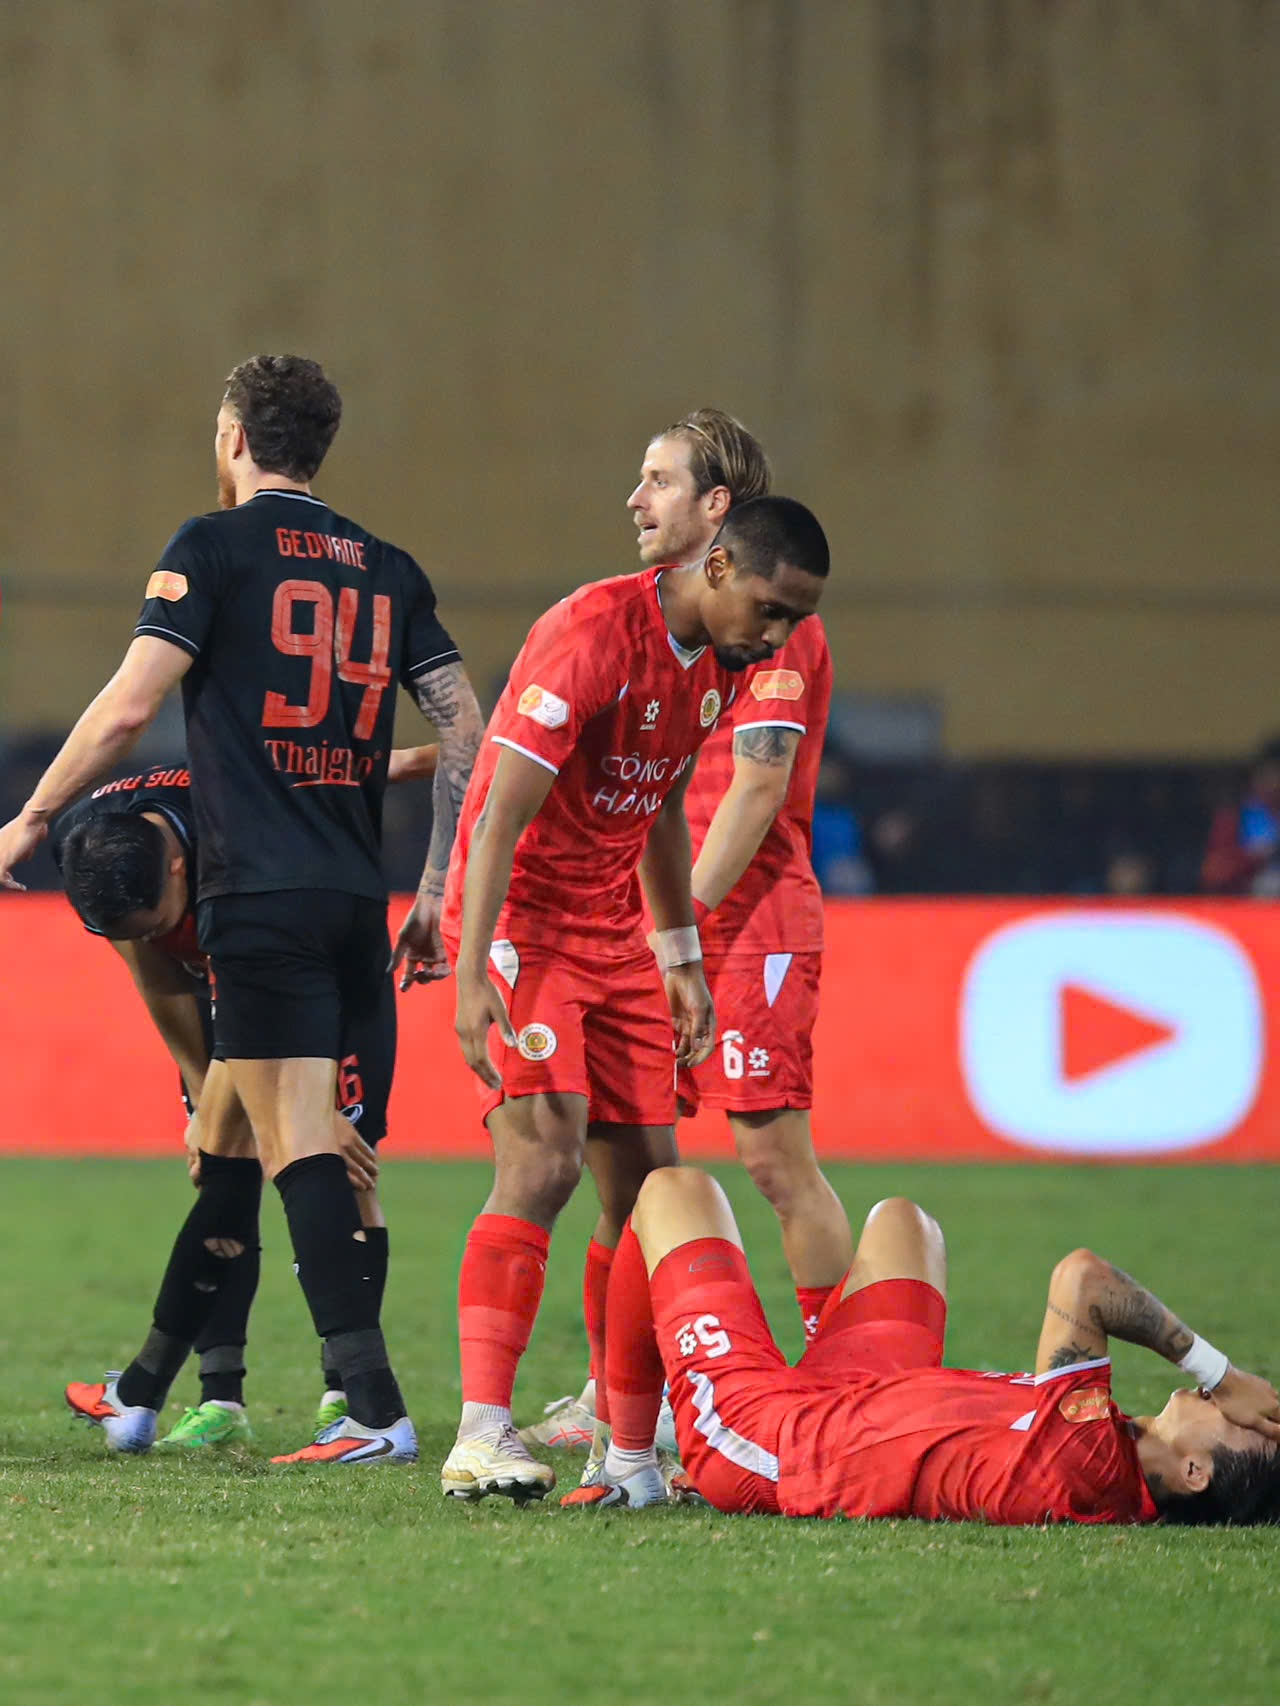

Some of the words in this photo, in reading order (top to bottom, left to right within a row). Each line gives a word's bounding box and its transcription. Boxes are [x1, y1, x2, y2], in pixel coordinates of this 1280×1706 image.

[276, 528, 367, 571] GEOVANE
[261, 578, 392, 741] 94
[721, 1029, 745, 1080] 6
[692, 1312, 733, 1359] 5
